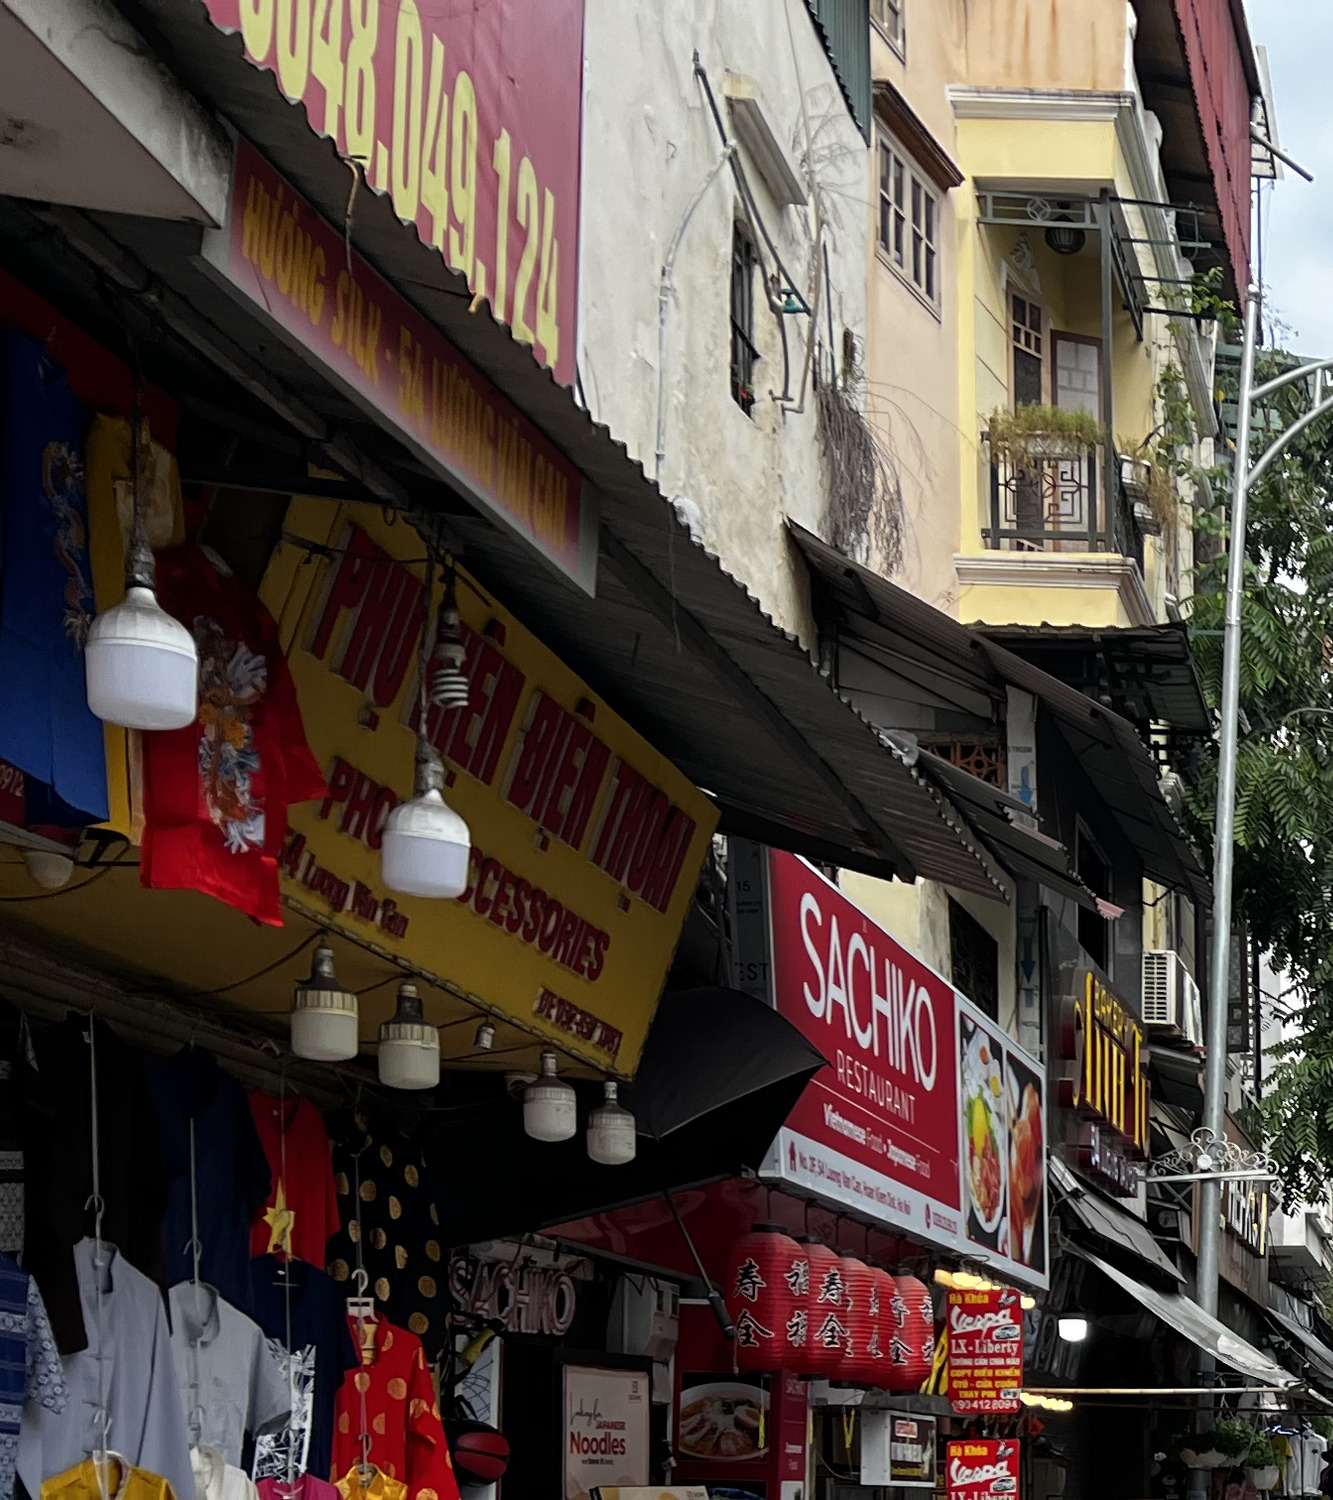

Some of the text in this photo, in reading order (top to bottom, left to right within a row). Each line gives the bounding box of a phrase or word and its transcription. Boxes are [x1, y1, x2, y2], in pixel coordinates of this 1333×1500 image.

[239, 0, 558, 369] 48.049.124
[332, 270, 383, 387] SILK
[318, 757, 610, 981] PHO CESSORIES
[590, 758, 698, 914] THOẠI
[800, 892, 937, 1092] SACHIKO
[836, 1050, 915, 1125] RESTAURANT
[823, 1103, 866, 1146] Vietnamese
[887, 1139, 916, 1172] Japanese
[448, 1256, 576, 1336] SACHIKO
[950, 1305, 1014, 1340] Vespa
[951, 1340, 968, 1354] LX
[975, 1339, 1019, 1357] Liberty
[570, 1431, 626, 1455] Noodles
[950, 1457, 1011, 1487] Vespa
